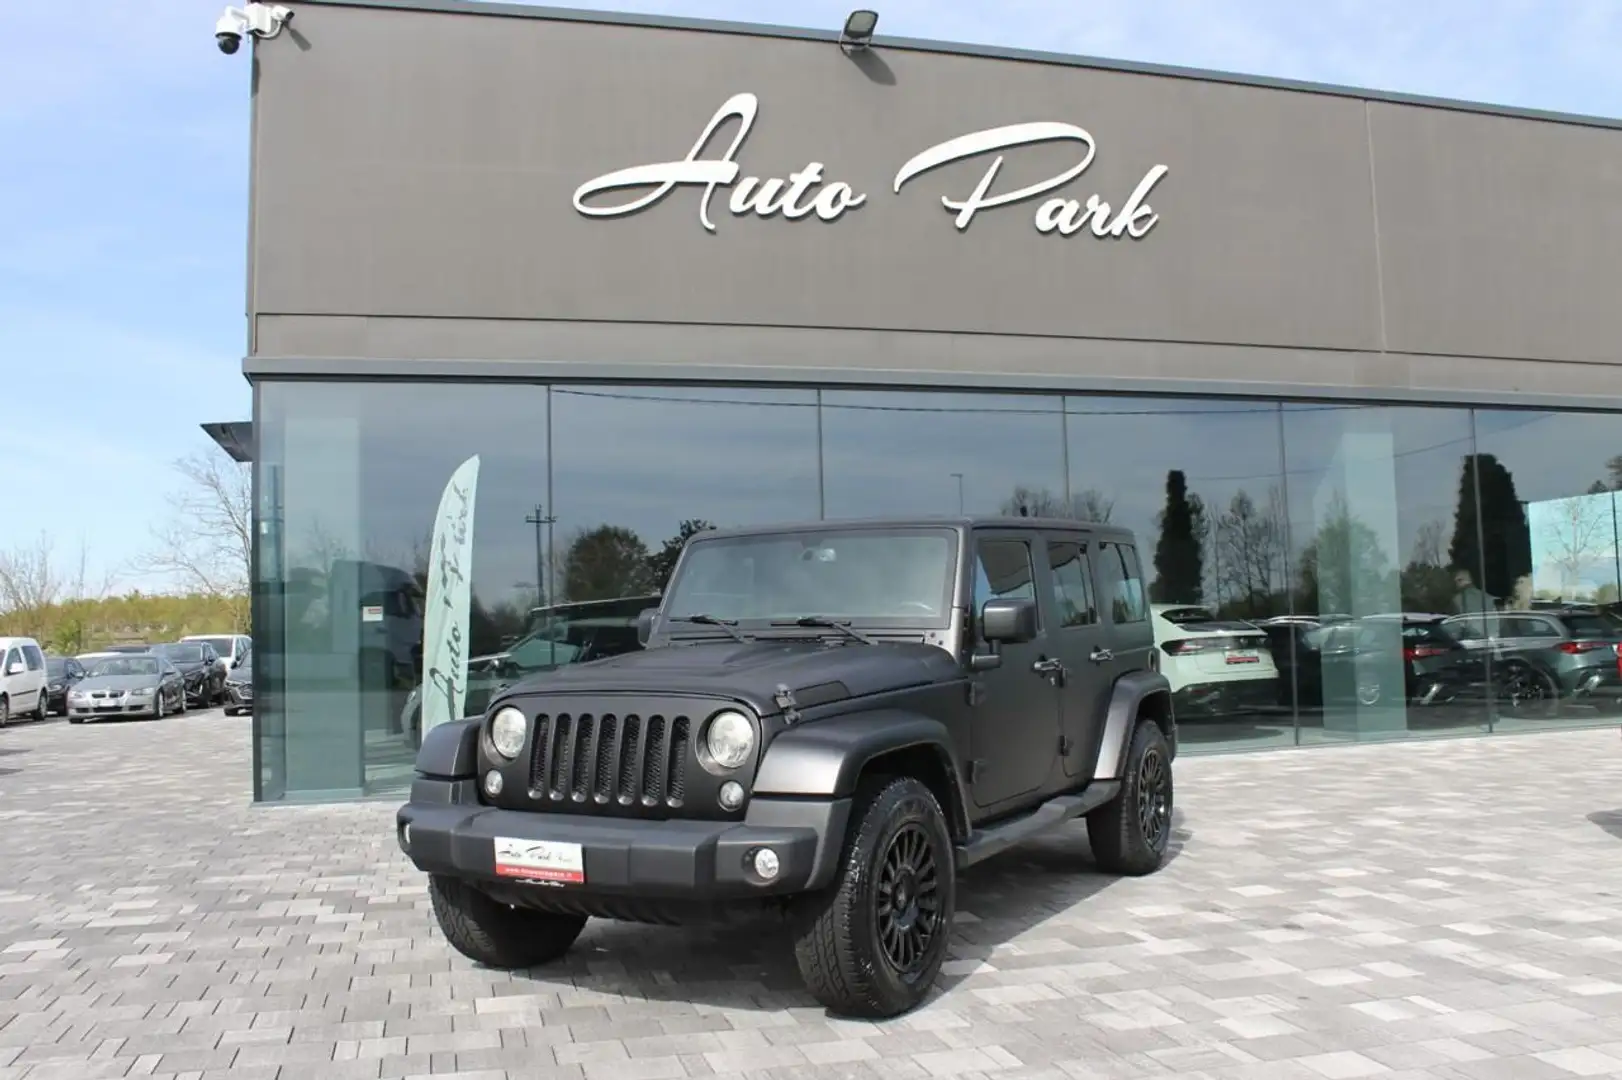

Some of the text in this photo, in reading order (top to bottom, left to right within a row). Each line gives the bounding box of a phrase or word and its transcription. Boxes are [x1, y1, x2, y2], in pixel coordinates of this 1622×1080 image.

[572, 92, 1169, 238] Auto Park
[429, 620, 464, 721] Auto
